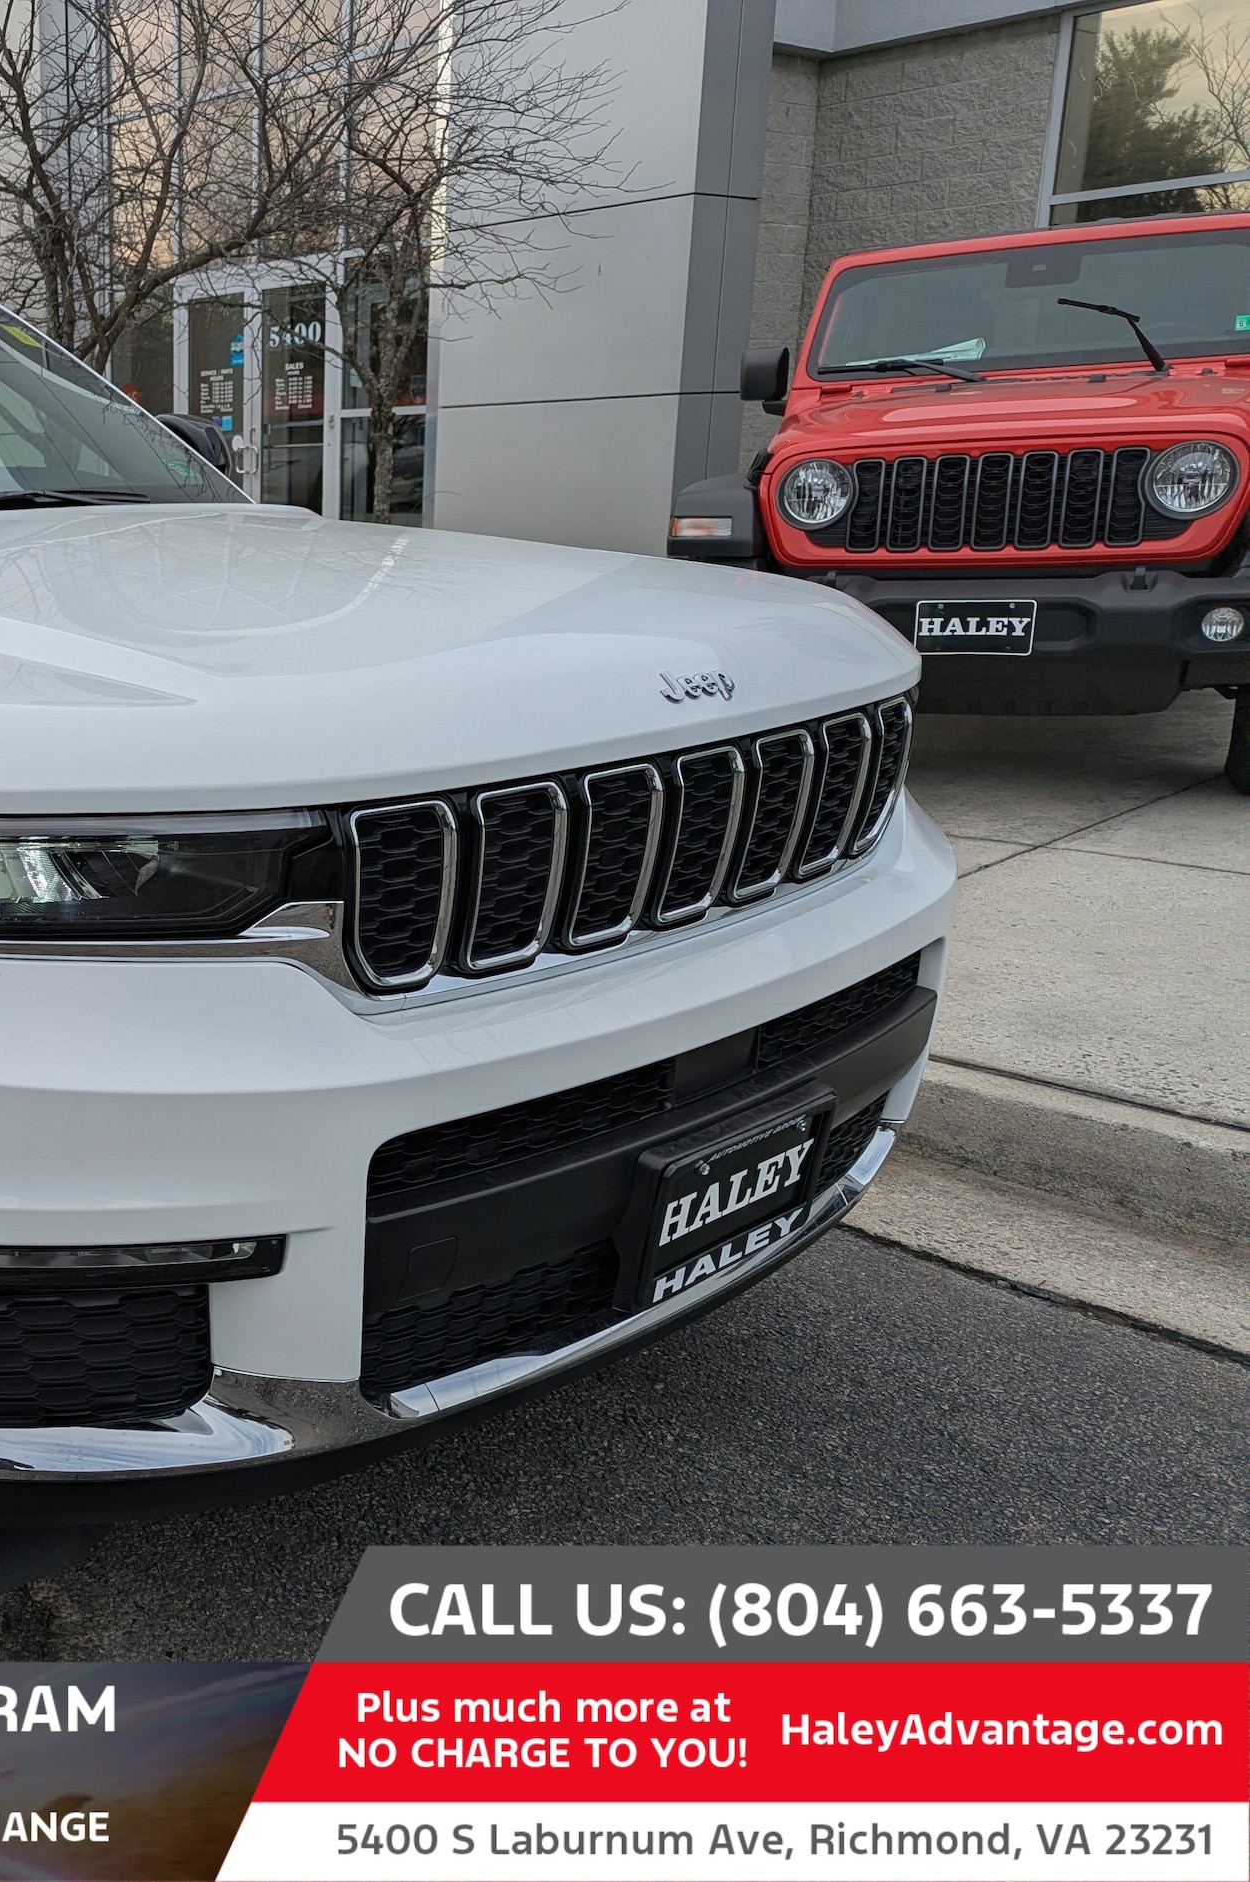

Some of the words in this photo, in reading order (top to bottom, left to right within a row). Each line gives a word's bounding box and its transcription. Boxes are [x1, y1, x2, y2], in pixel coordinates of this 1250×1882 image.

[269, 321, 322, 348] 5400
[285, 362, 305, 371] SALES
[918, 617, 1032, 637] HALEY
[659, 669, 736, 704] Jeep
[659, 1138, 815, 1248] HALEY
[652, 1207, 805, 1304] HALEY
